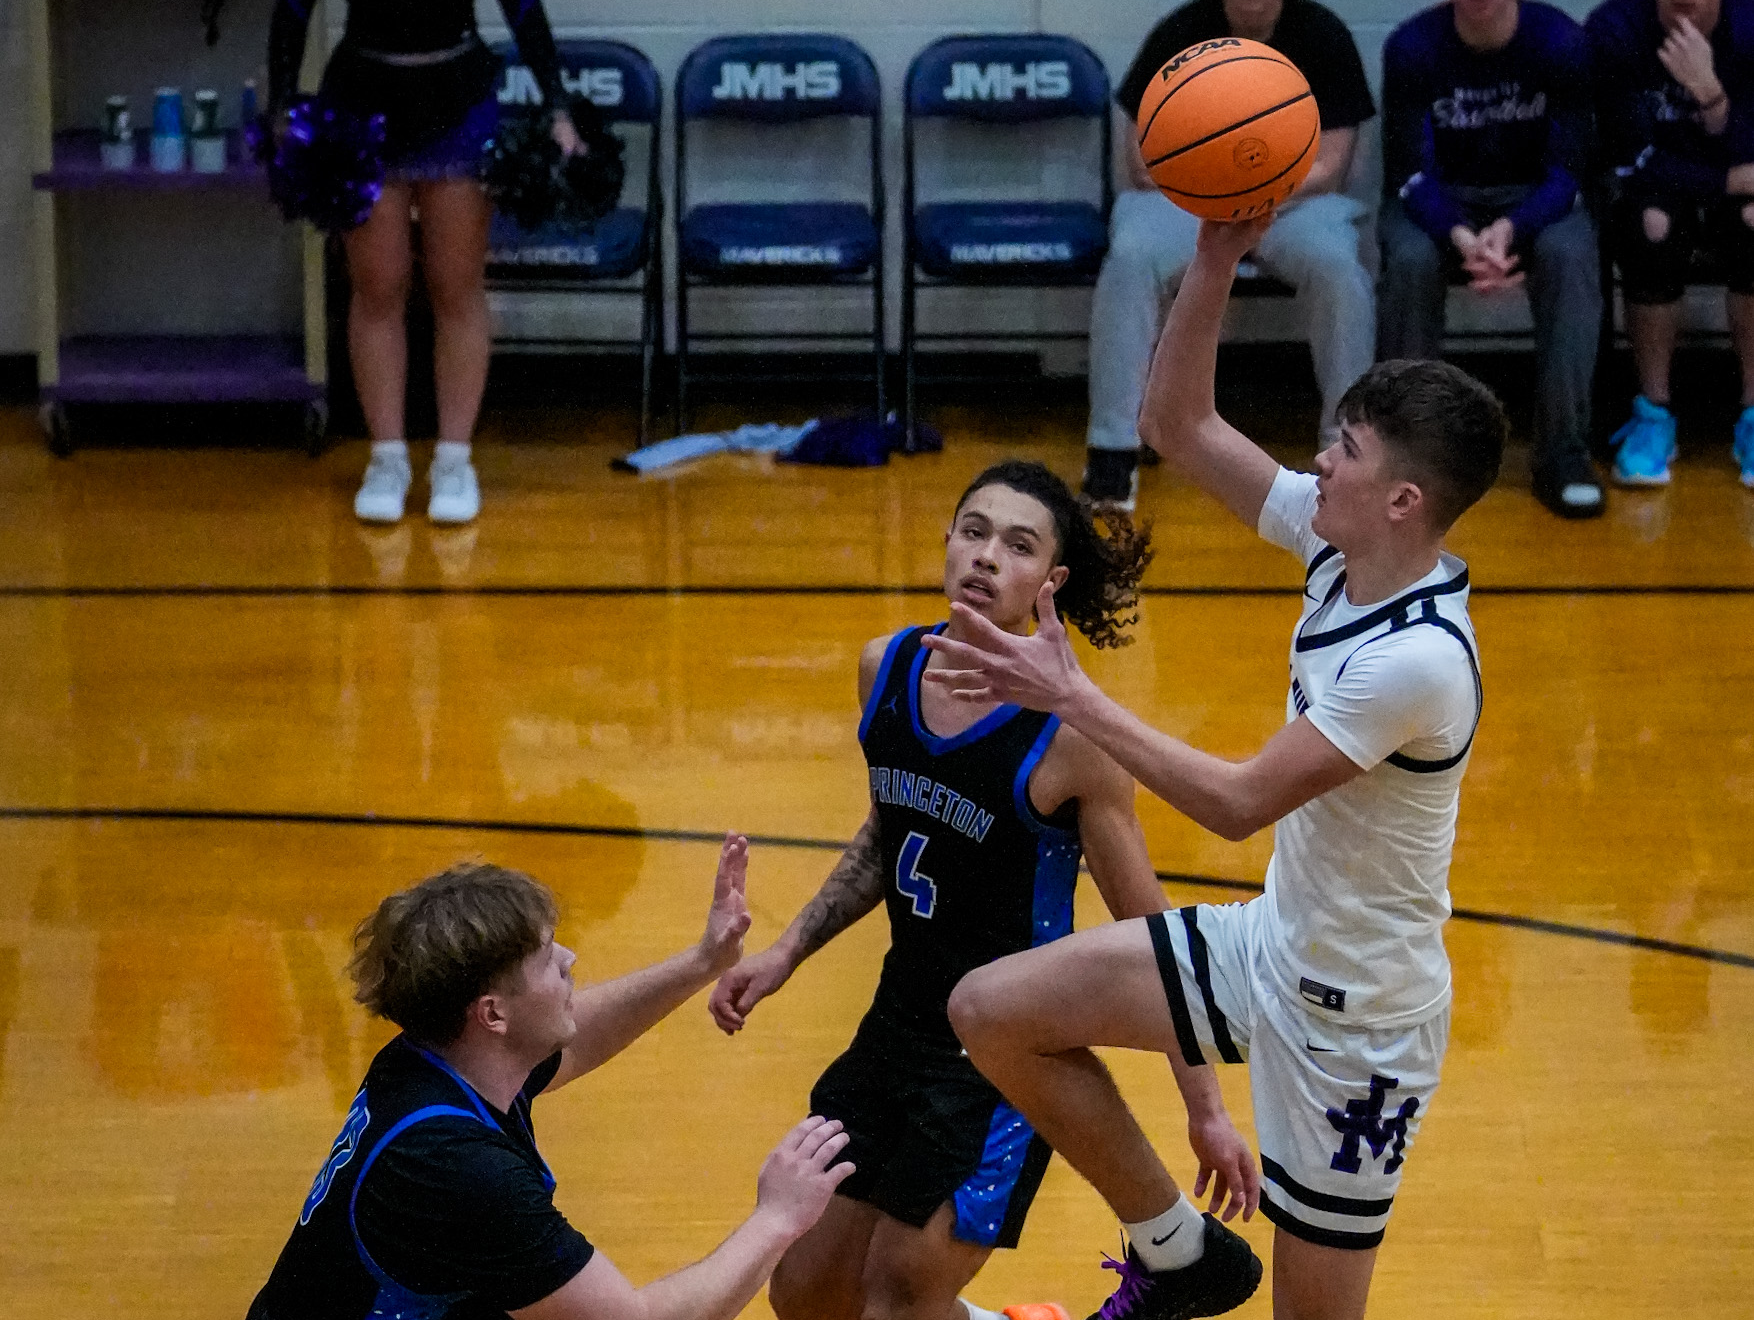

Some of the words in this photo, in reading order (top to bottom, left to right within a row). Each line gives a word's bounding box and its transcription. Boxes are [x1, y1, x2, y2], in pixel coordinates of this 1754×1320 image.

[1162, 38, 1242, 82] NCAA
[713, 61, 841, 99] JMHS
[943, 61, 1072, 100] JMHS
[720, 246, 841, 263] MAVERICKS
[951, 243, 1072, 262] MAVERICKS
[869, 767, 995, 843] PRINCETON
[896, 830, 937, 919] 4
[1329, 994, 1338, 1005] S
